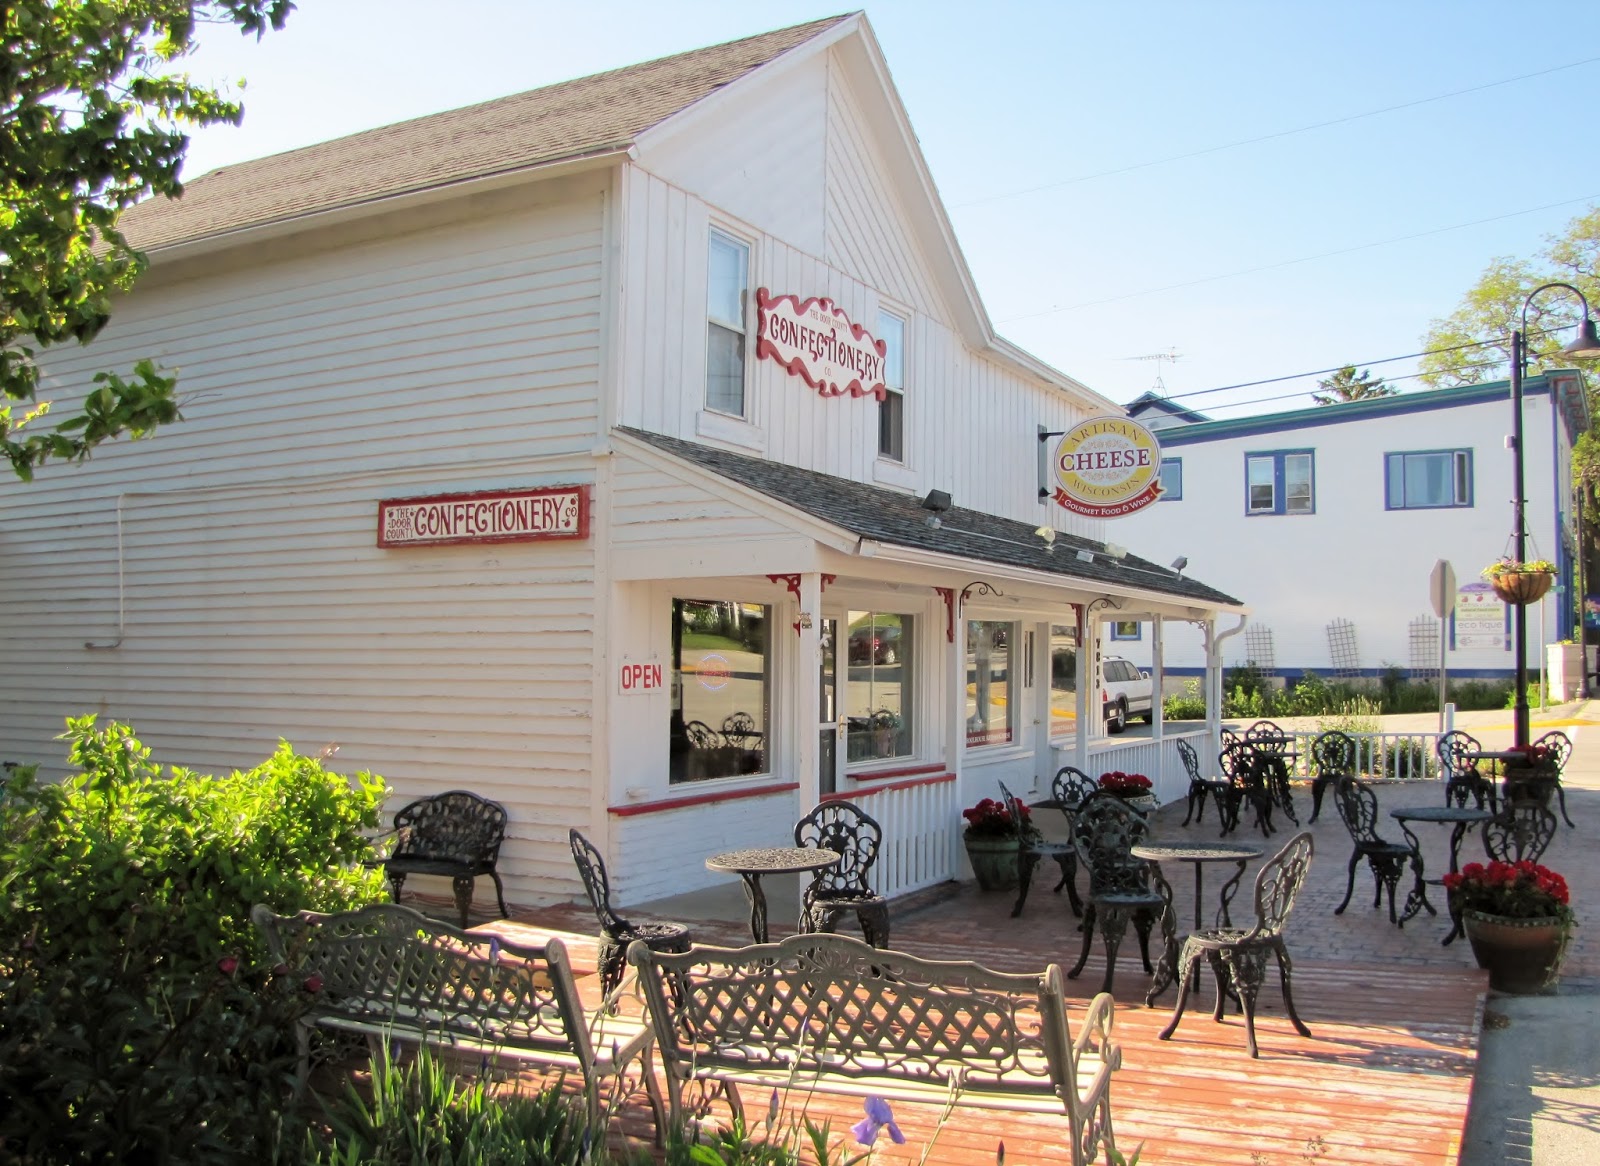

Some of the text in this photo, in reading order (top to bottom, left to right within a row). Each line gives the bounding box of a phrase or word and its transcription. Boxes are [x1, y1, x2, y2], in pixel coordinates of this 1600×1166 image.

[810, 309, 848, 333] THE DOOR COUNTY
[770, 313, 879, 381] CONFECTIONERY
[1071, 423, 1141, 447] ARTISAN
[1060, 449, 1150, 471] CHEESE
[1073, 479, 1140, 496] WISCONSIN
[396, 507, 409, 518] THE
[414, 496, 565, 537] CONFECTIONERY
[1122, 504, 1129, 512] &
[386, 527, 414, 539] COUNTY
[391, 518, 411, 528] DOOR
[621, 664, 662, 690] OPEN
